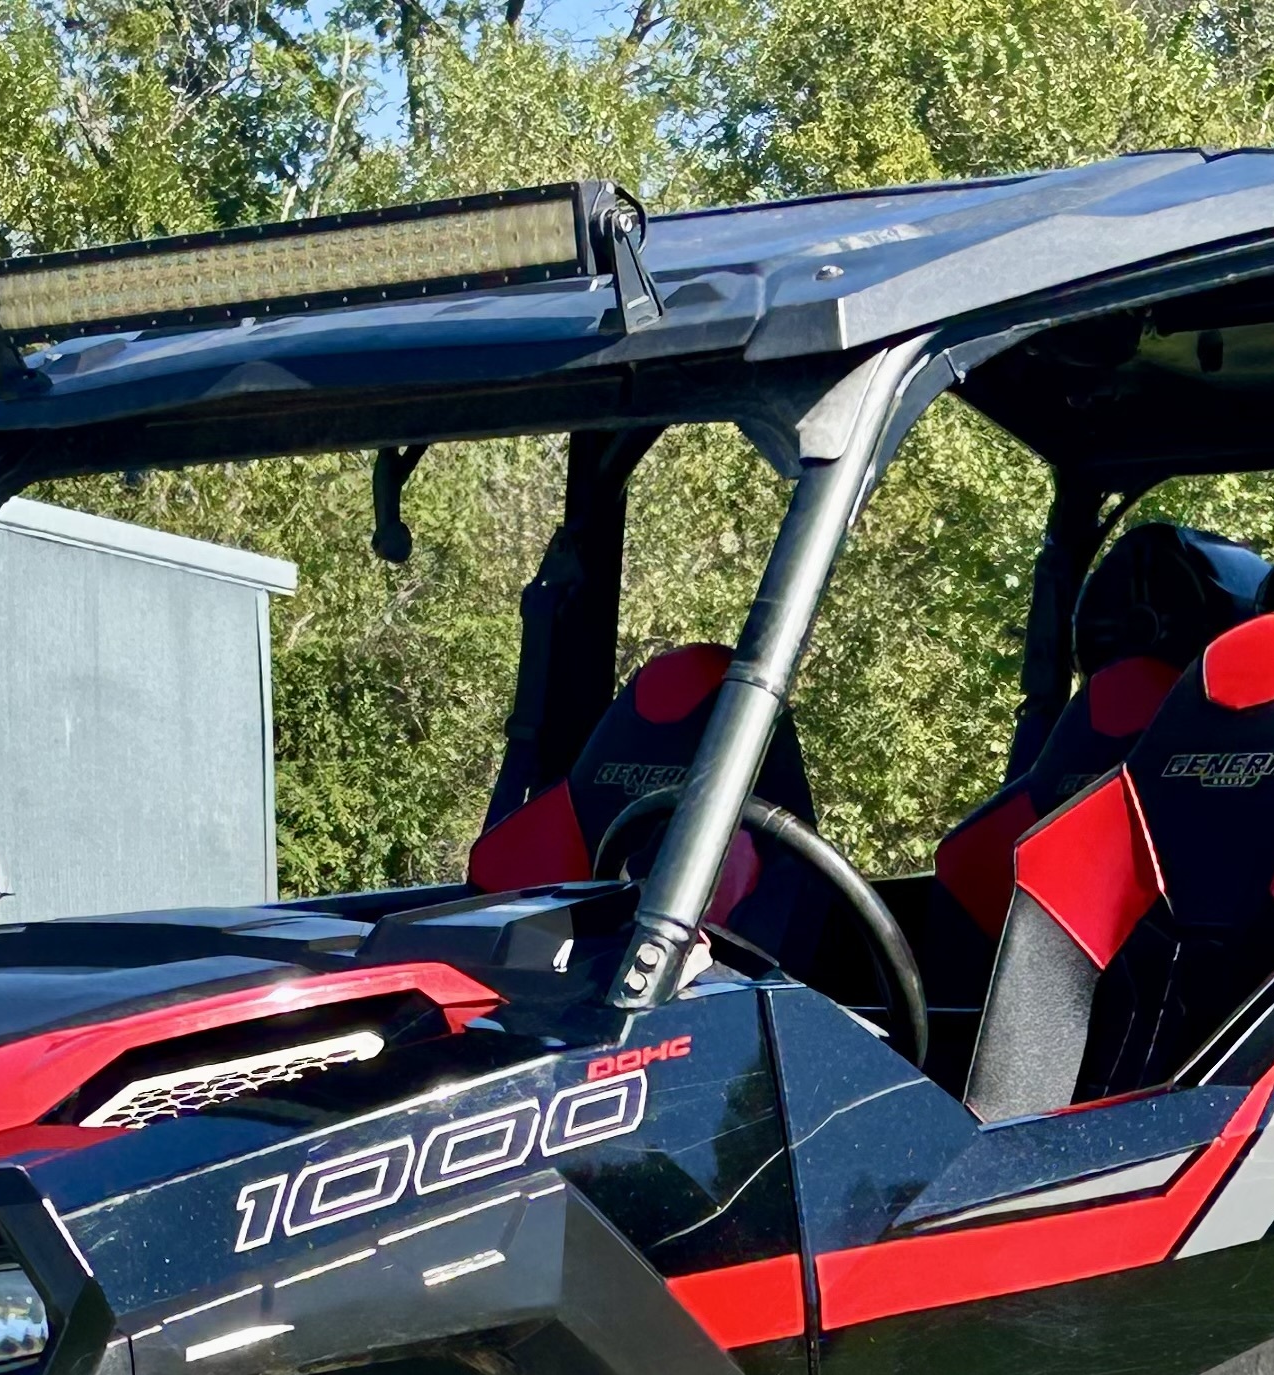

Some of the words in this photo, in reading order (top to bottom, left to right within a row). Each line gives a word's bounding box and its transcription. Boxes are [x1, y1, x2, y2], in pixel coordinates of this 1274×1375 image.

[593, 763, 689, 786] GENER
[588, 1036, 692, 1080] DOHC
[234, 1069, 647, 1252] 1000
